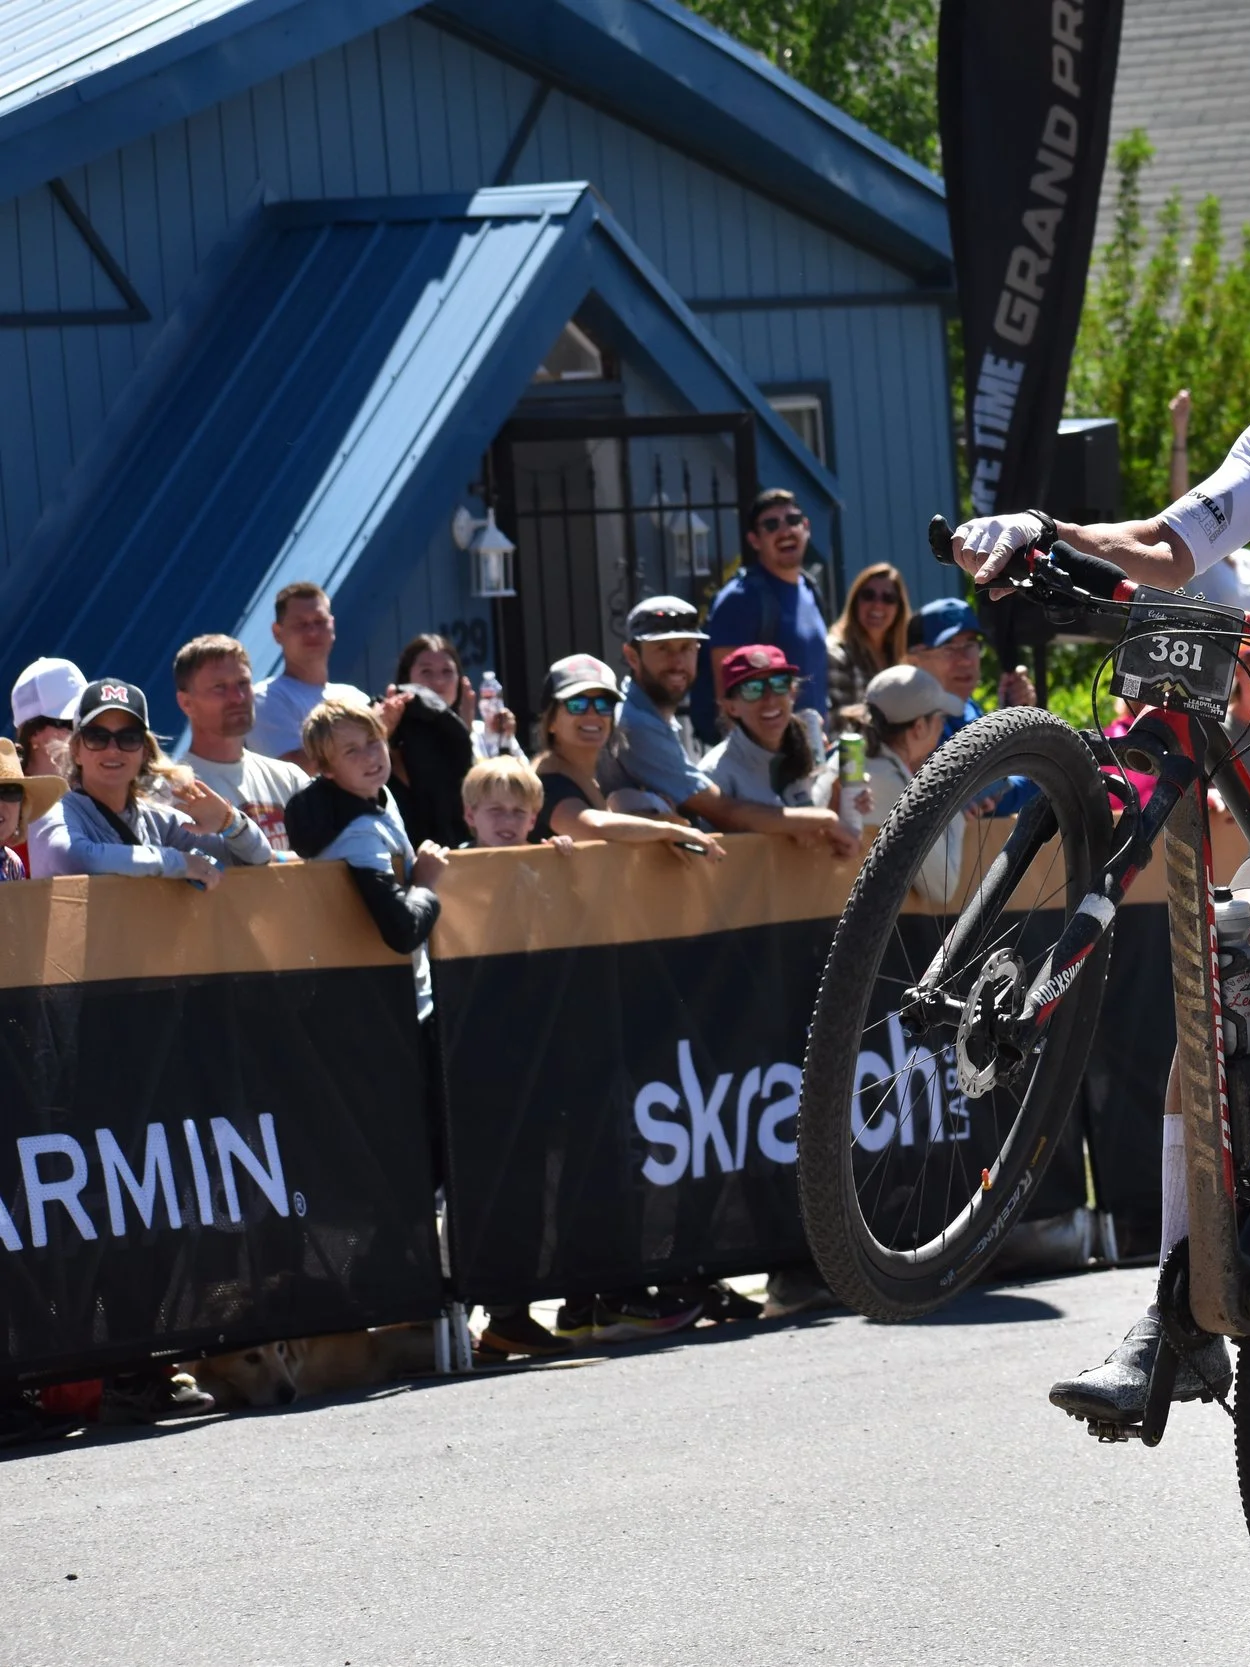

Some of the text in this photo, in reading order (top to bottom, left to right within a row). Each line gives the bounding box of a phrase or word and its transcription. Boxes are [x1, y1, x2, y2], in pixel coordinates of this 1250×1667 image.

[971, 458, 1002, 518] IFE
[994, 104, 1079, 346] GRAND
[1051, 0, 1084, 99] PR
[1148, 635, 1204, 672] 381
[101, 684, 129, 704] M
[1187, 698, 1222, 711] LEADVILLE
[1030, 956, 1086, 1007] ROCKSHO
[634, 1010, 945, 1188] skrach
